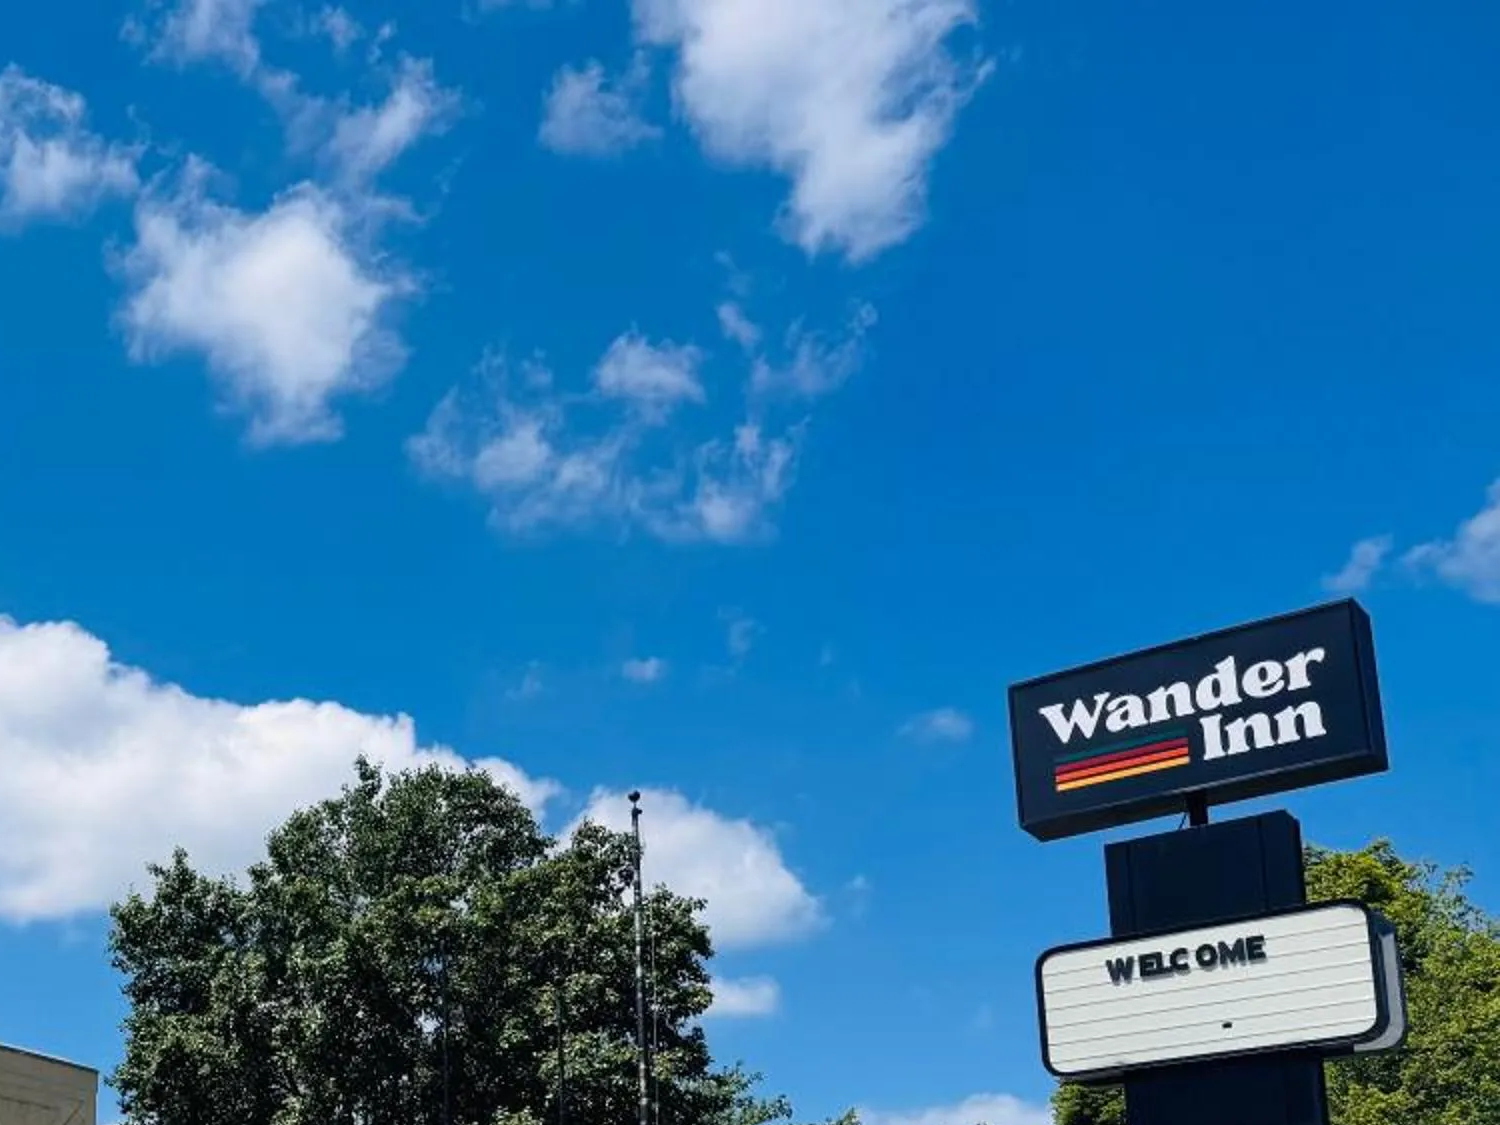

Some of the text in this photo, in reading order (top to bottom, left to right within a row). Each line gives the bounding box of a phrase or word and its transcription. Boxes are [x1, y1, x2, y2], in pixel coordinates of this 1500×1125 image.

[1039, 647, 1326, 744] Wander
[1199, 700, 1327, 761] Inn
[1106, 935, 1267, 984] WELCOME
